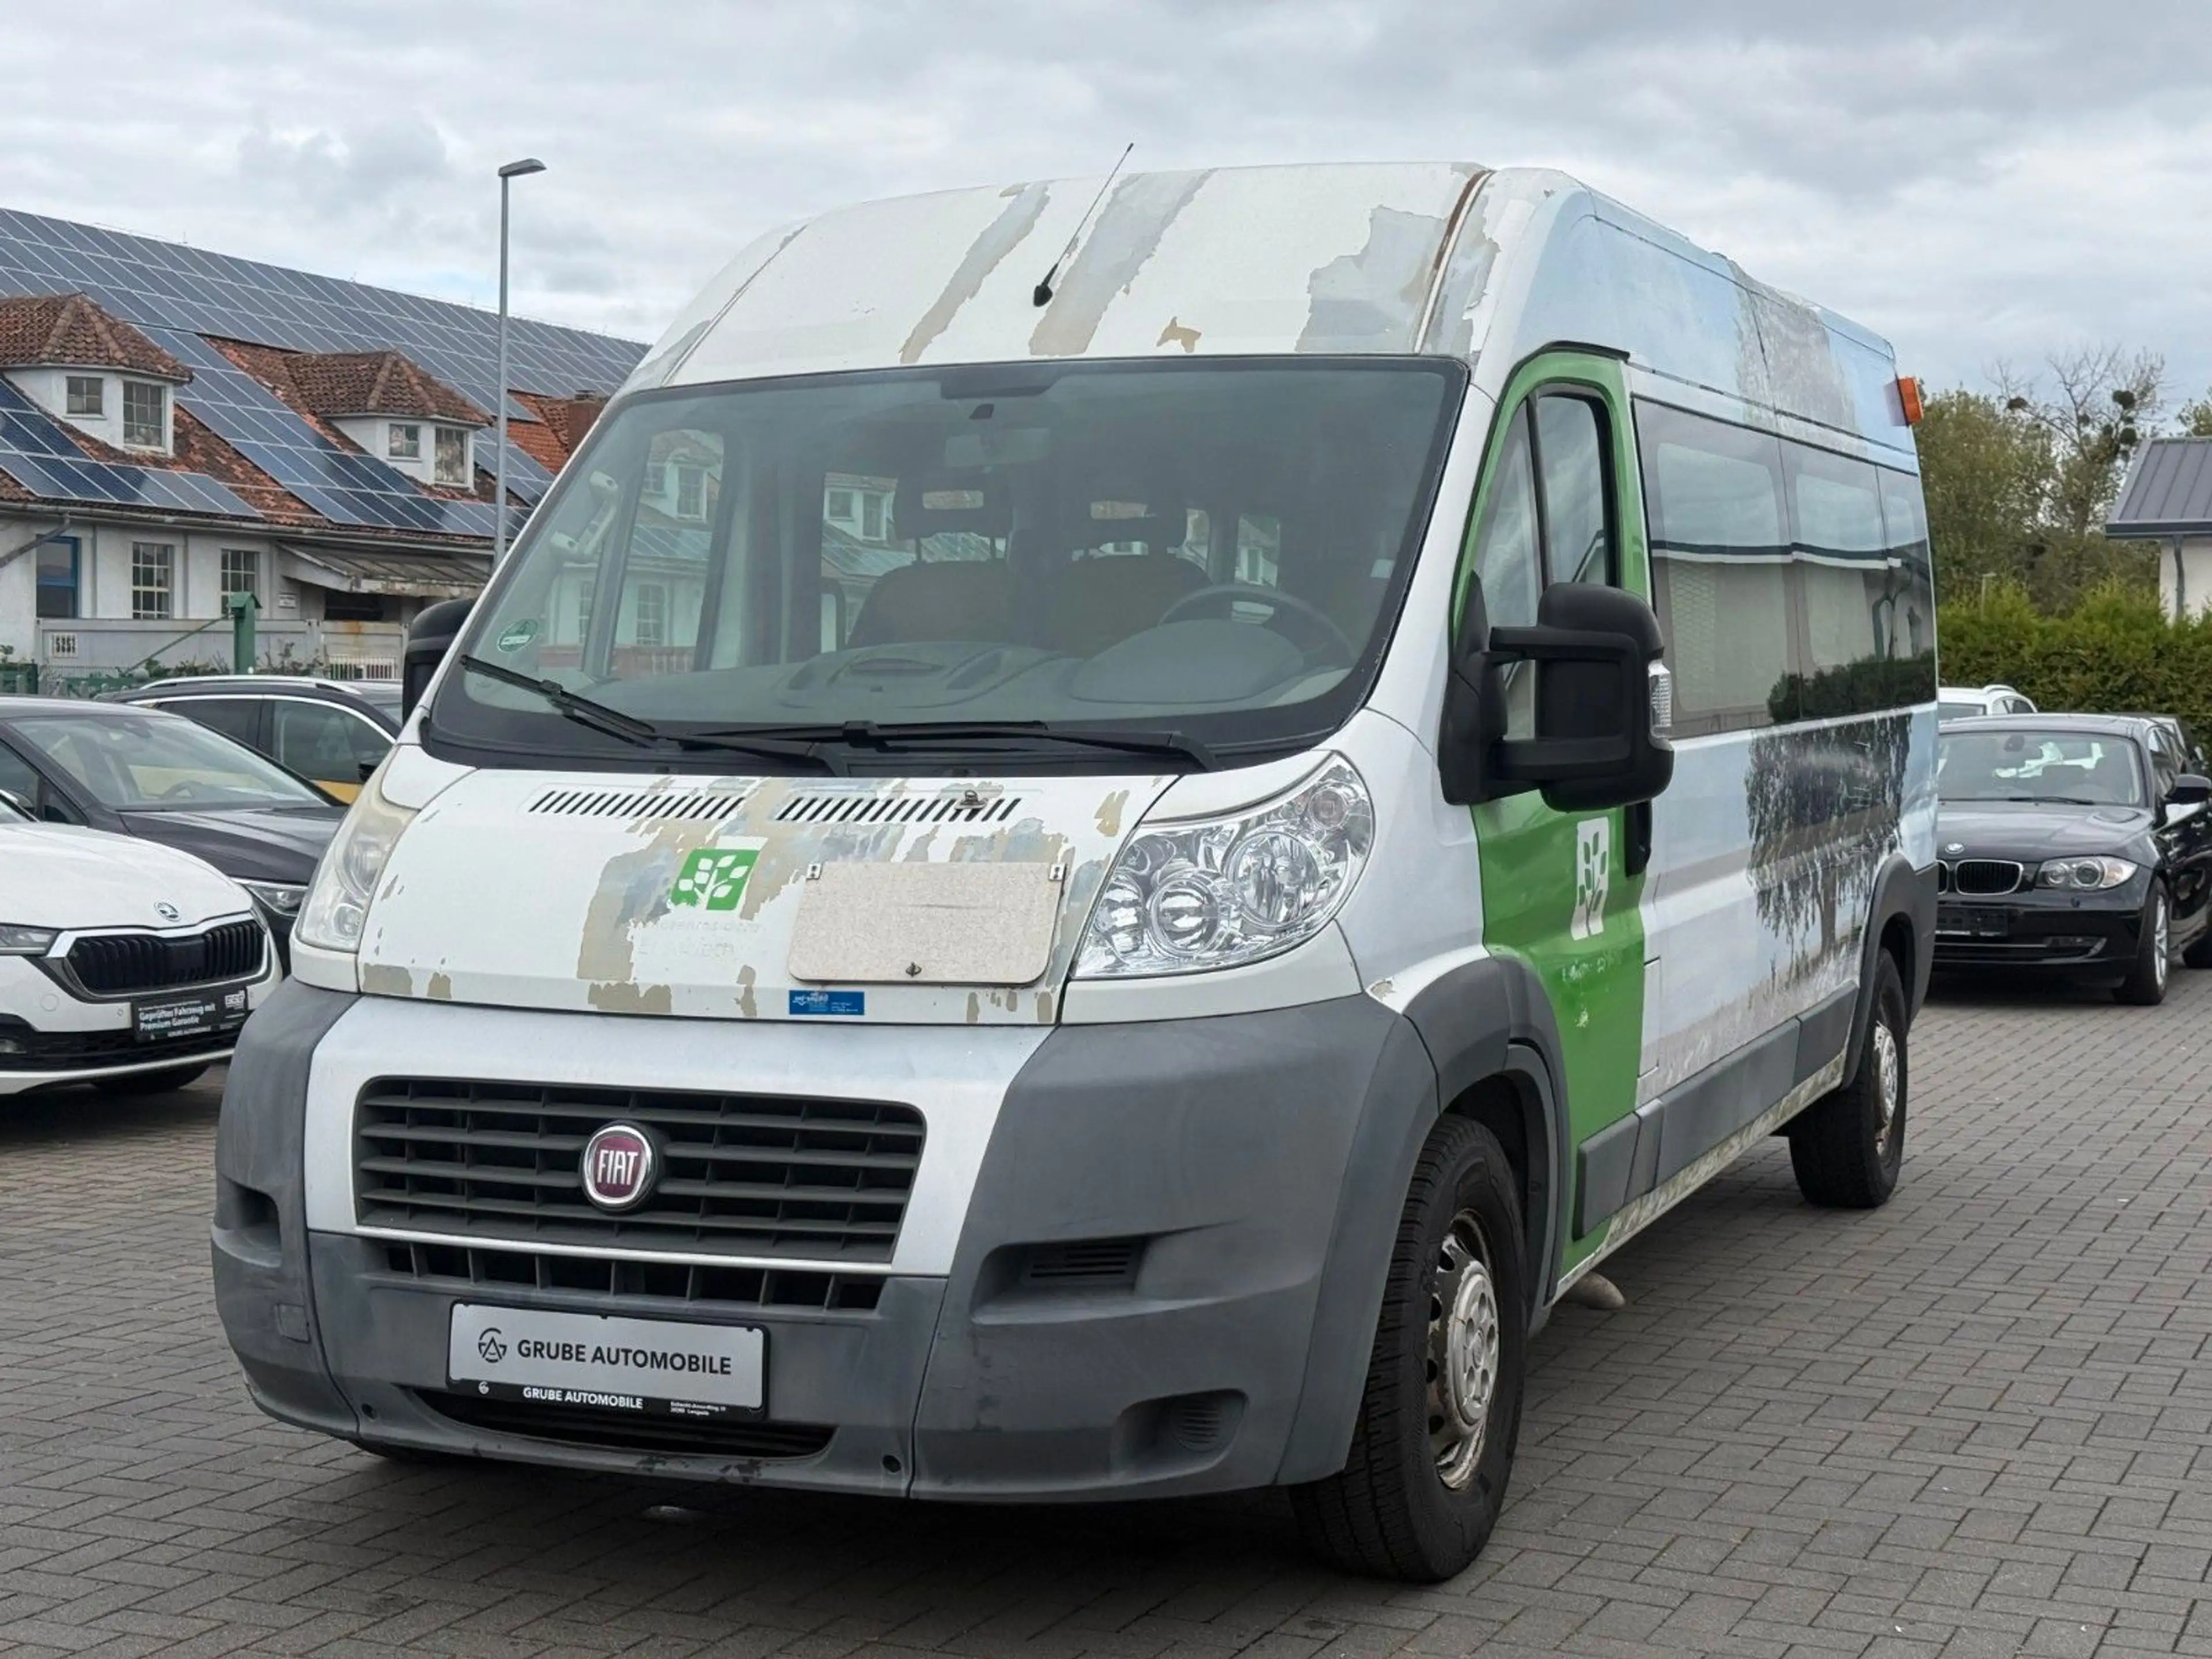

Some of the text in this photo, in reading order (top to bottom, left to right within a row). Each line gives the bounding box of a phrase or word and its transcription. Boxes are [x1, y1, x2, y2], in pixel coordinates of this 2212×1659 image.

[597, 1149, 639, 1185] FIAT
[518, 1339, 732, 1376] GRUBE AUTOMOBILE
[523, 1387, 643, 1409] GRUBE AUTOMOBILE
